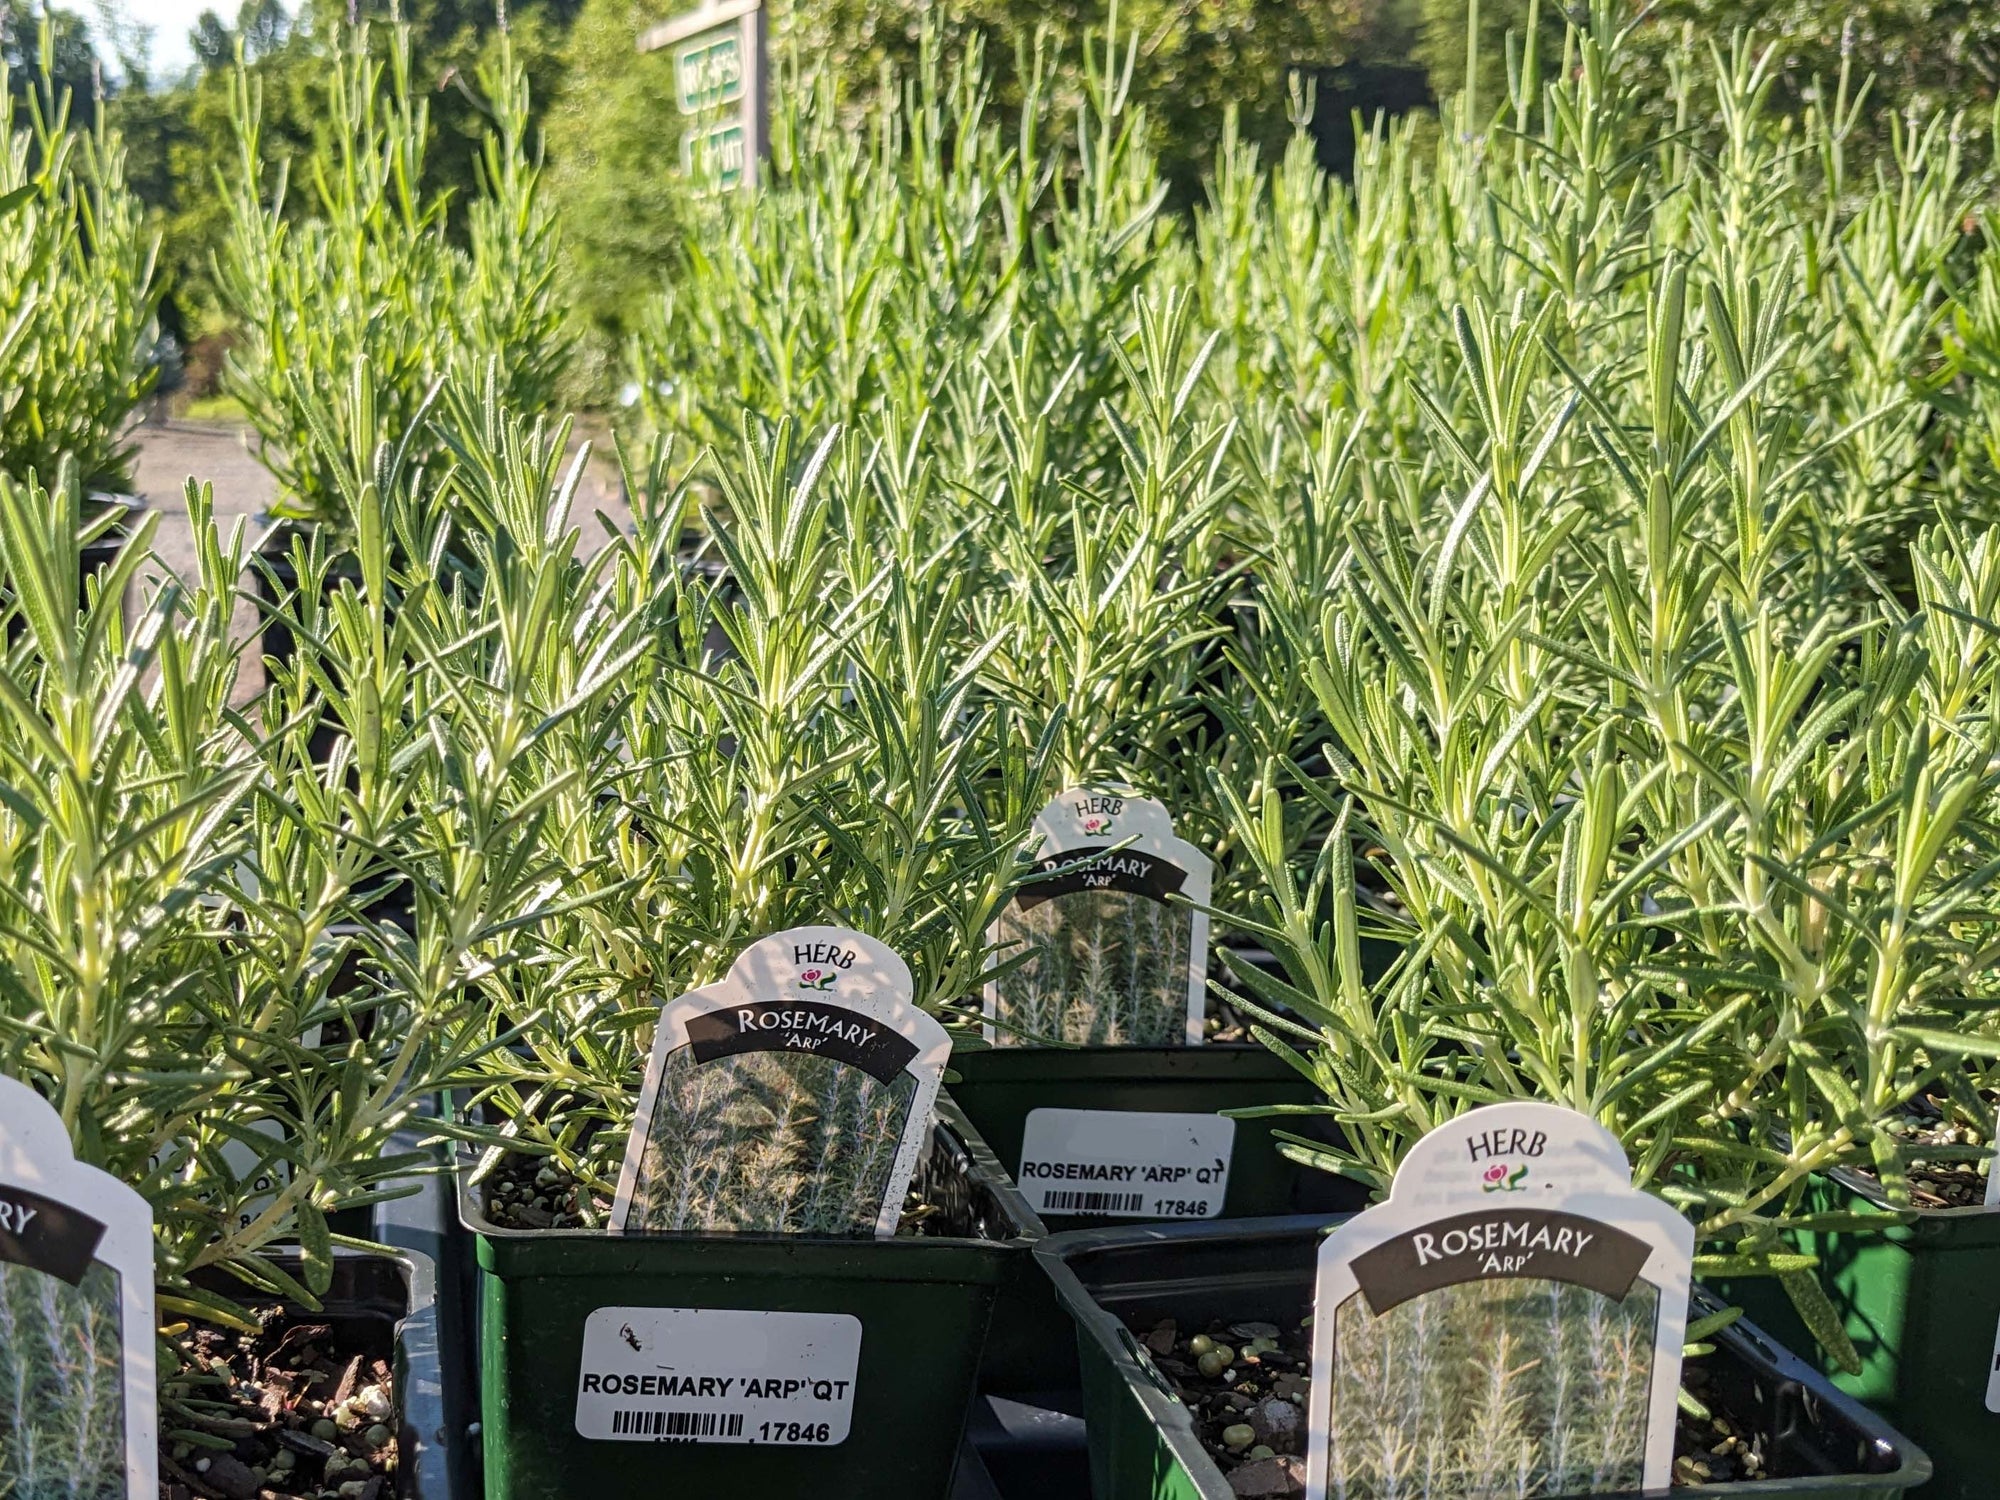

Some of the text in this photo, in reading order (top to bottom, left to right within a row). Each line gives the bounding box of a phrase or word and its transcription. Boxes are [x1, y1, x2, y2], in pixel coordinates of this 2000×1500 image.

[1075, 796, 1123, 818] HERB
[794, 943, 856, 970] HERB
[738, 1009, 876, 1048] ROSEMARY
[1466, 1128, 1548, 1163] HERB
[1022, 1162, 1221, 1184] ROSEMARY 'ARP' QT
[1154, 1200, 1208, 1216] 17846
[1412, 1221, 1593, 1266] ROSEMARY
[583, 1374, 849, 1401] ROSEMARY 'ARP' QT
[759, 1422, 830, 1442] 17846
